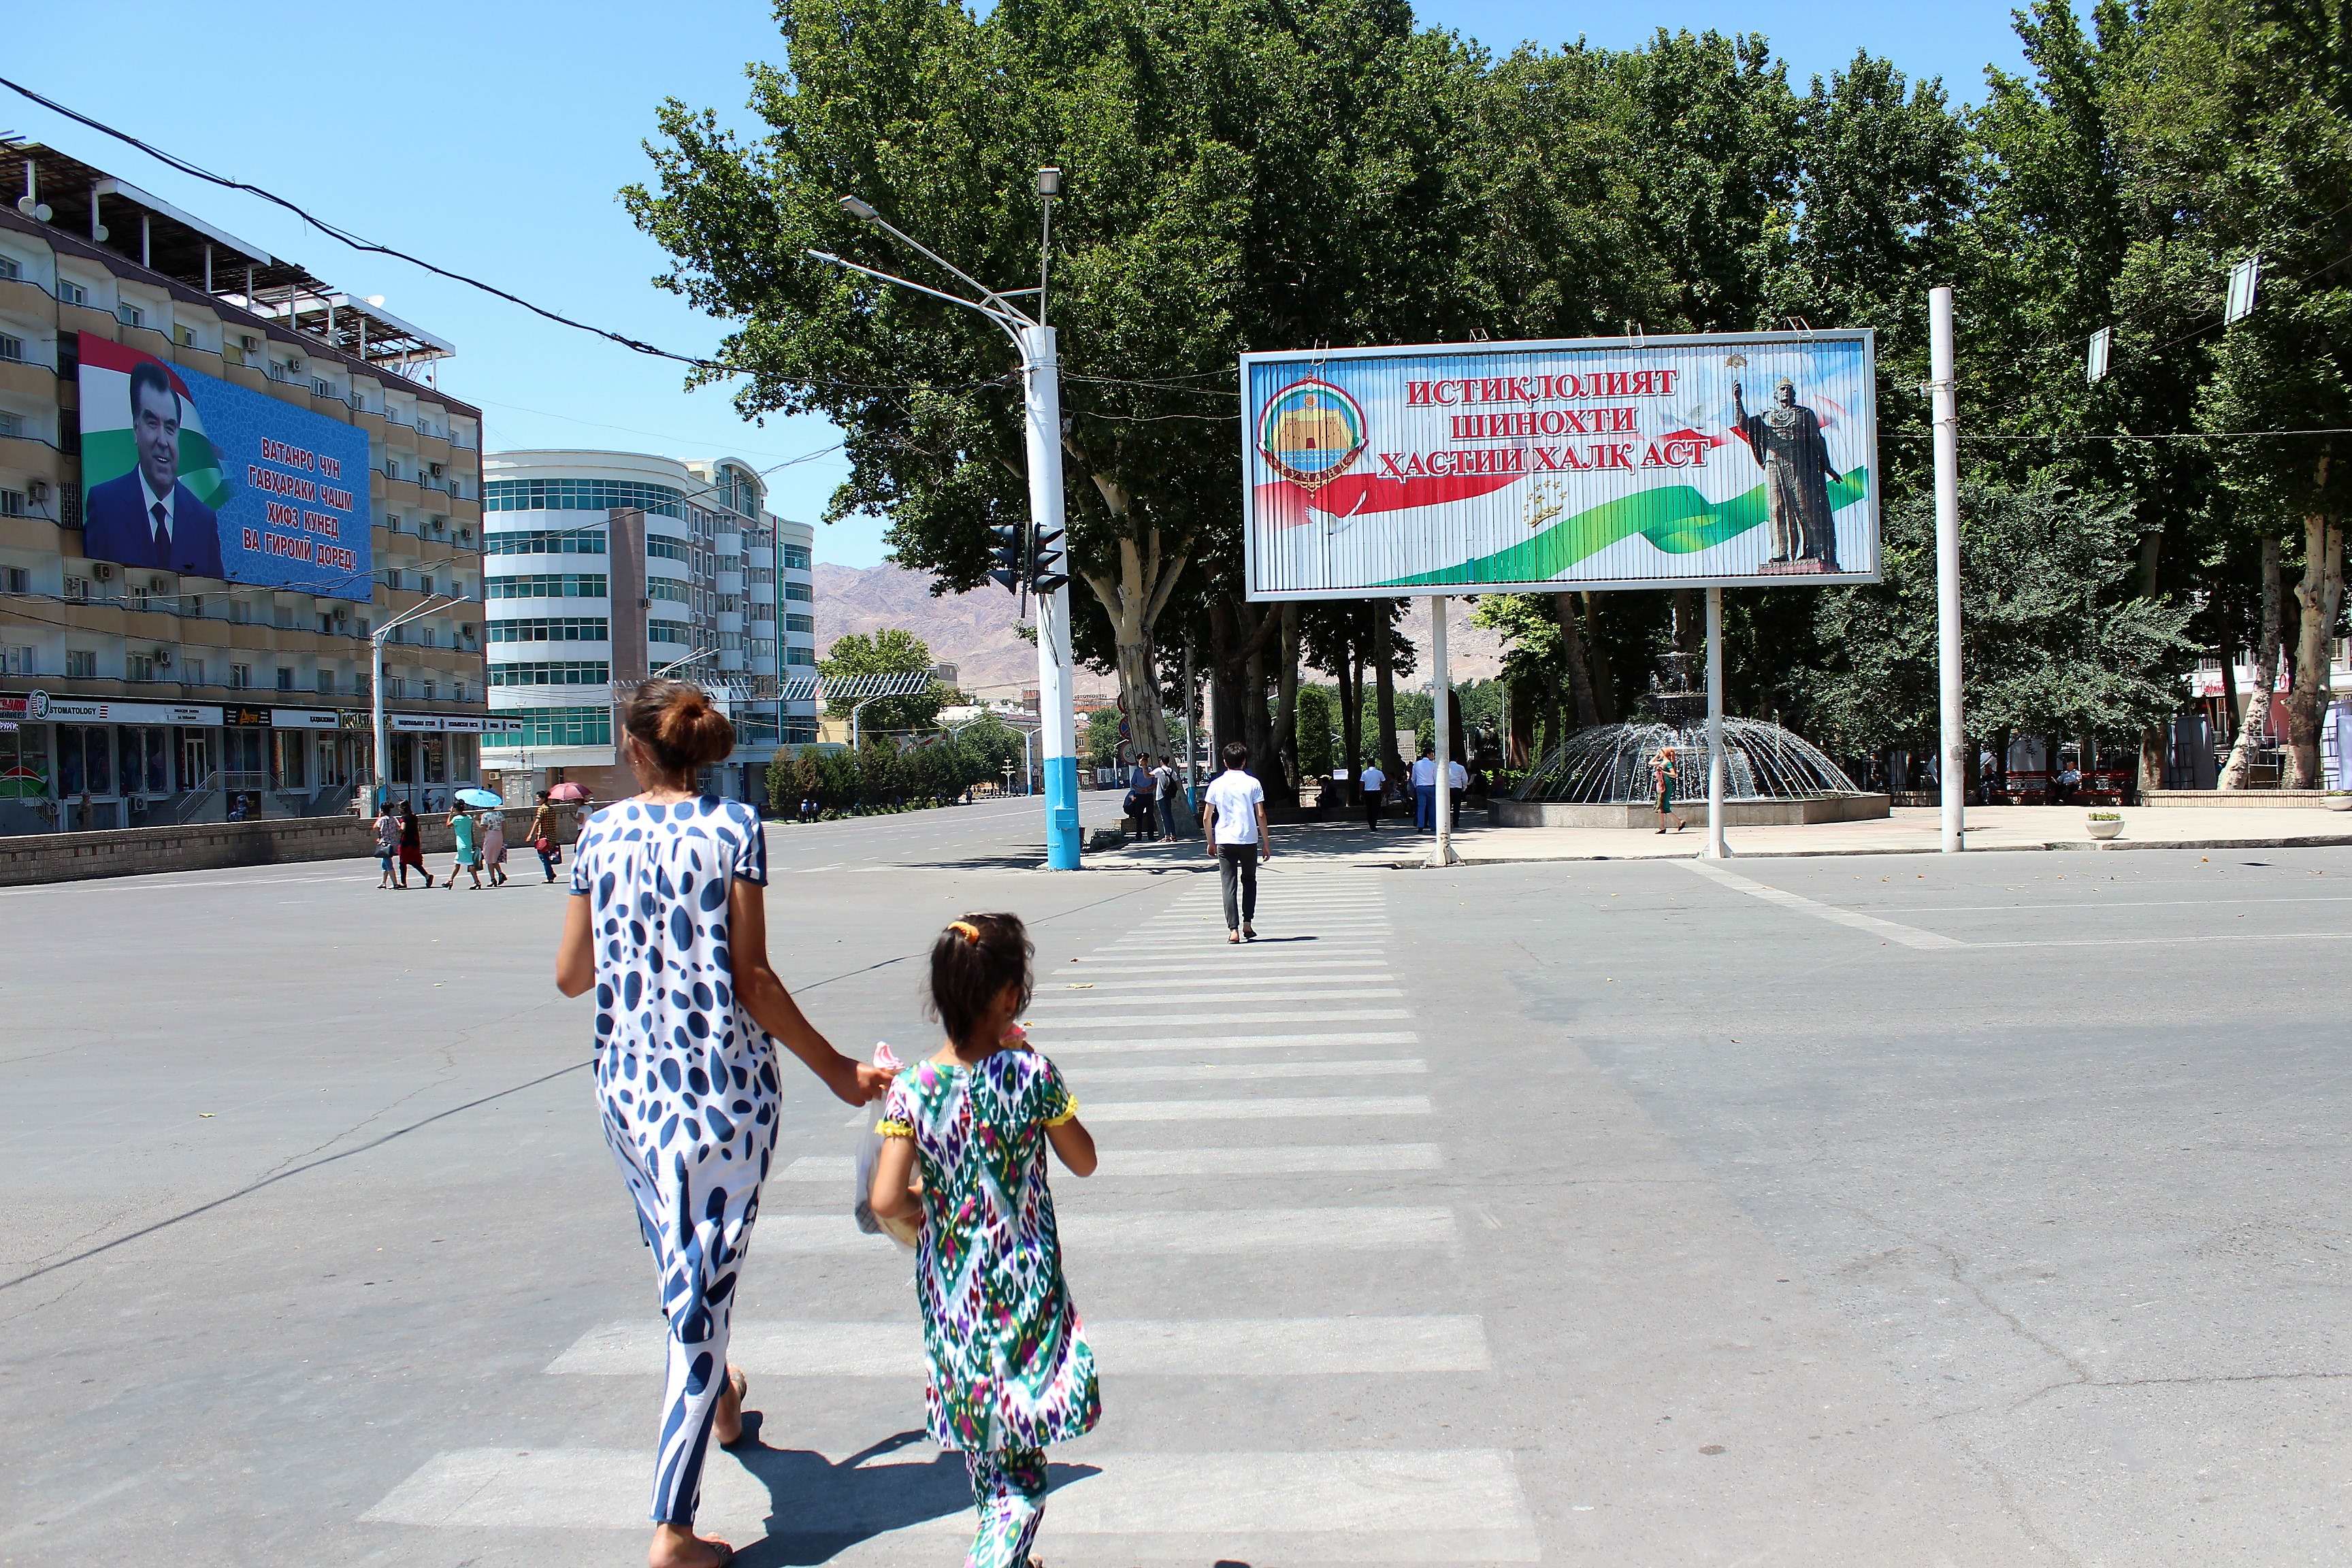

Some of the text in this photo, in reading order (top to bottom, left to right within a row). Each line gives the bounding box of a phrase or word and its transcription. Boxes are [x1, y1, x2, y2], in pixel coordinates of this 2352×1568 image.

[1405, 370, 1678, 408] ИСТИҚЛОЛИЯТ
[1450, 407, 1639, 441] ШИНОХТИ
[261, 436, 341, 480] ВАТАНРО ЧУН
[1377, 438, 1710, 483] ҲАСТИИ ХАЛҚ АСТ
[248, 464, 353, 512] ГАВҲАРАКИ ЧАШМ
[266, 501, 340, 542] ҲИФЗ КУНЕД
[243, 527, 357, 573] ВА ГИРОМӢ ДОРЕД!
[50, 706, 97, 715] STOMATOLOGY
